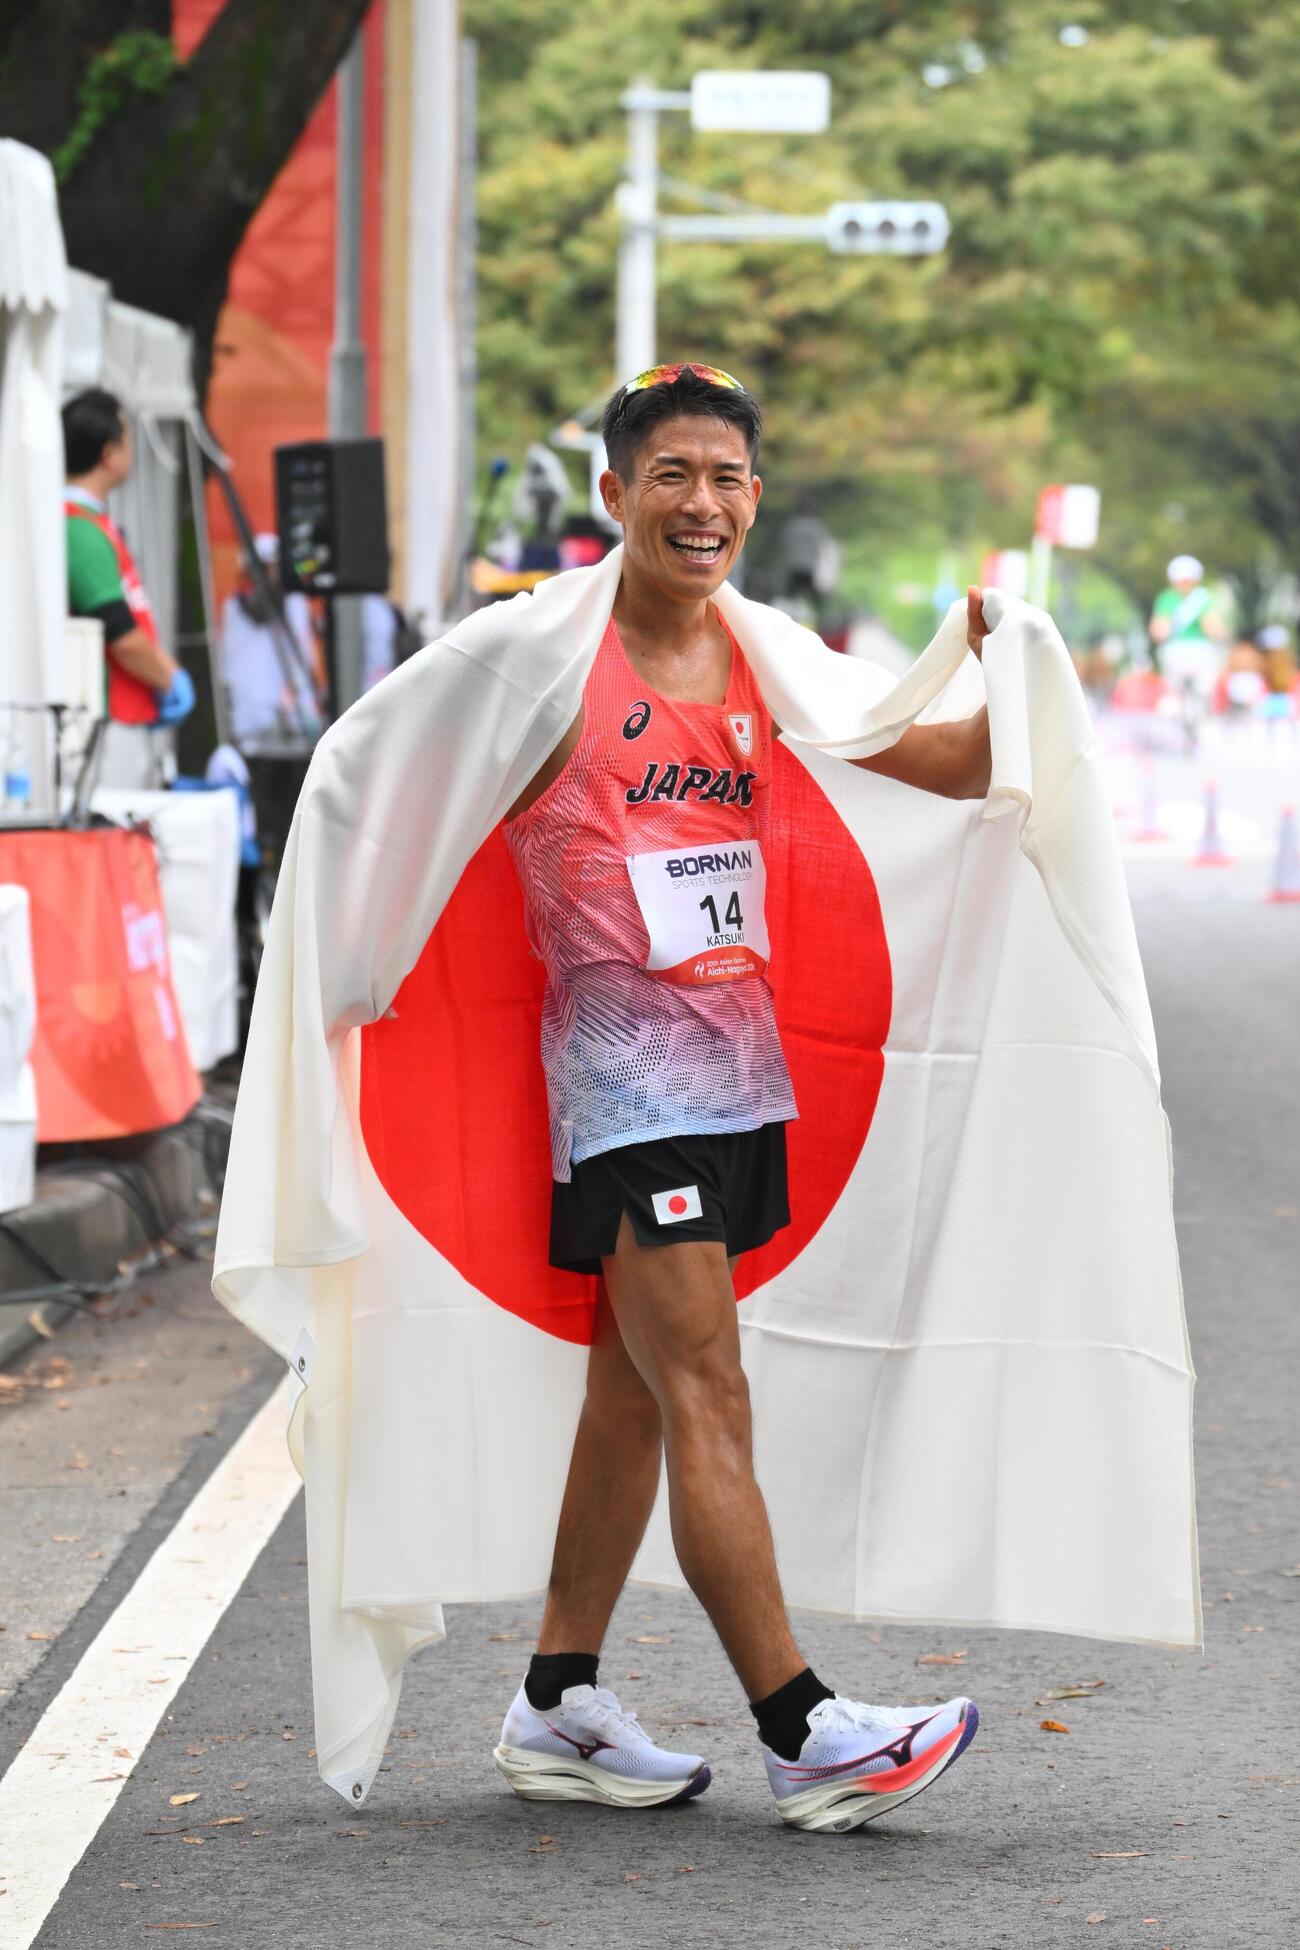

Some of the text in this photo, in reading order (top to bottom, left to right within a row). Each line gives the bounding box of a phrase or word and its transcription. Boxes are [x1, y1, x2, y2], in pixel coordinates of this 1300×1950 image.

[625, 762, 758, 807] JAPAN
[665, 850, 752, 878] BORNAN
[672, 871, 752, 890] SPORTS TECHNOLOG
[699, 891, 744, 934] 14
[706, 932, 745, 947] KATSUKI
